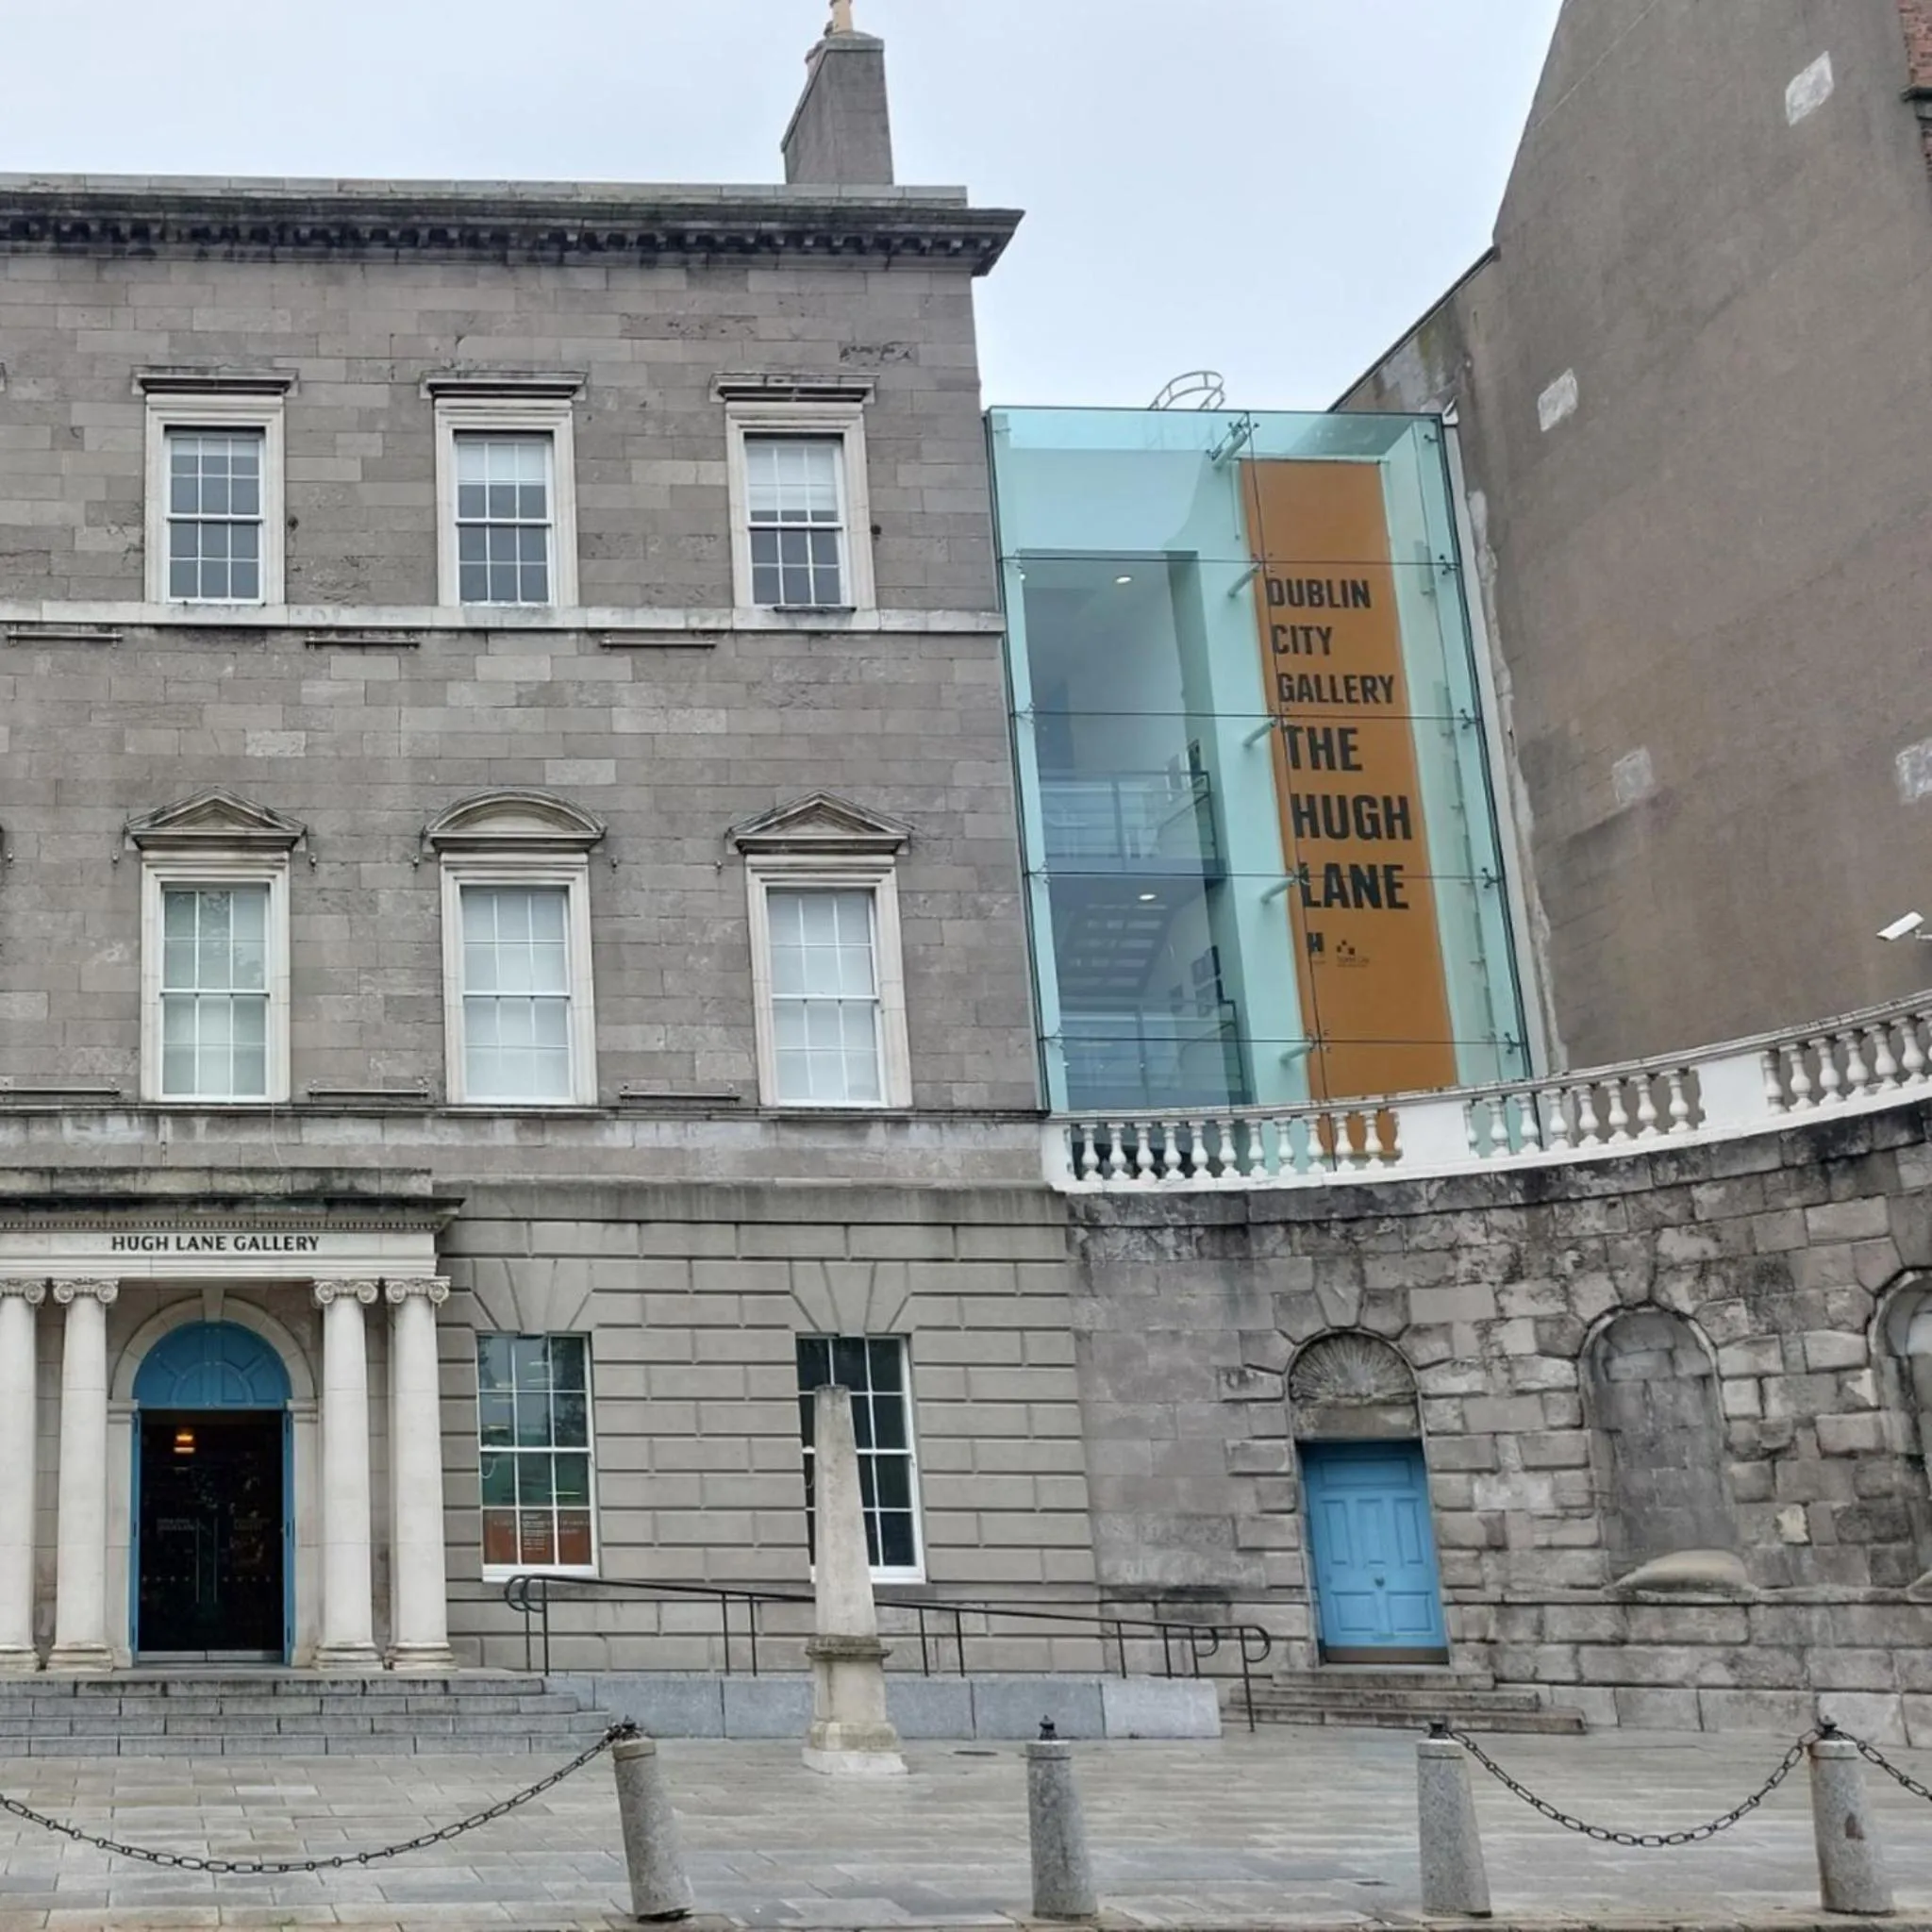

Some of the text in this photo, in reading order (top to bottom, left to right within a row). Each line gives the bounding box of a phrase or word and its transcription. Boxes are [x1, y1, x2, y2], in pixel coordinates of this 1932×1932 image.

[1266, 577, 1372, 608] DUBLIN
[1272, 624, 1333, 656] CITY
[1276, 673, 1394, 705] GALLERY
[1283, 724, 1363, 772] THE
[1290, 792, 1412, 841] HUGH
[1299, 862, 1409, 910] LANE
[111, 1235, 320, 1252] HUGH LANE GALLERY
